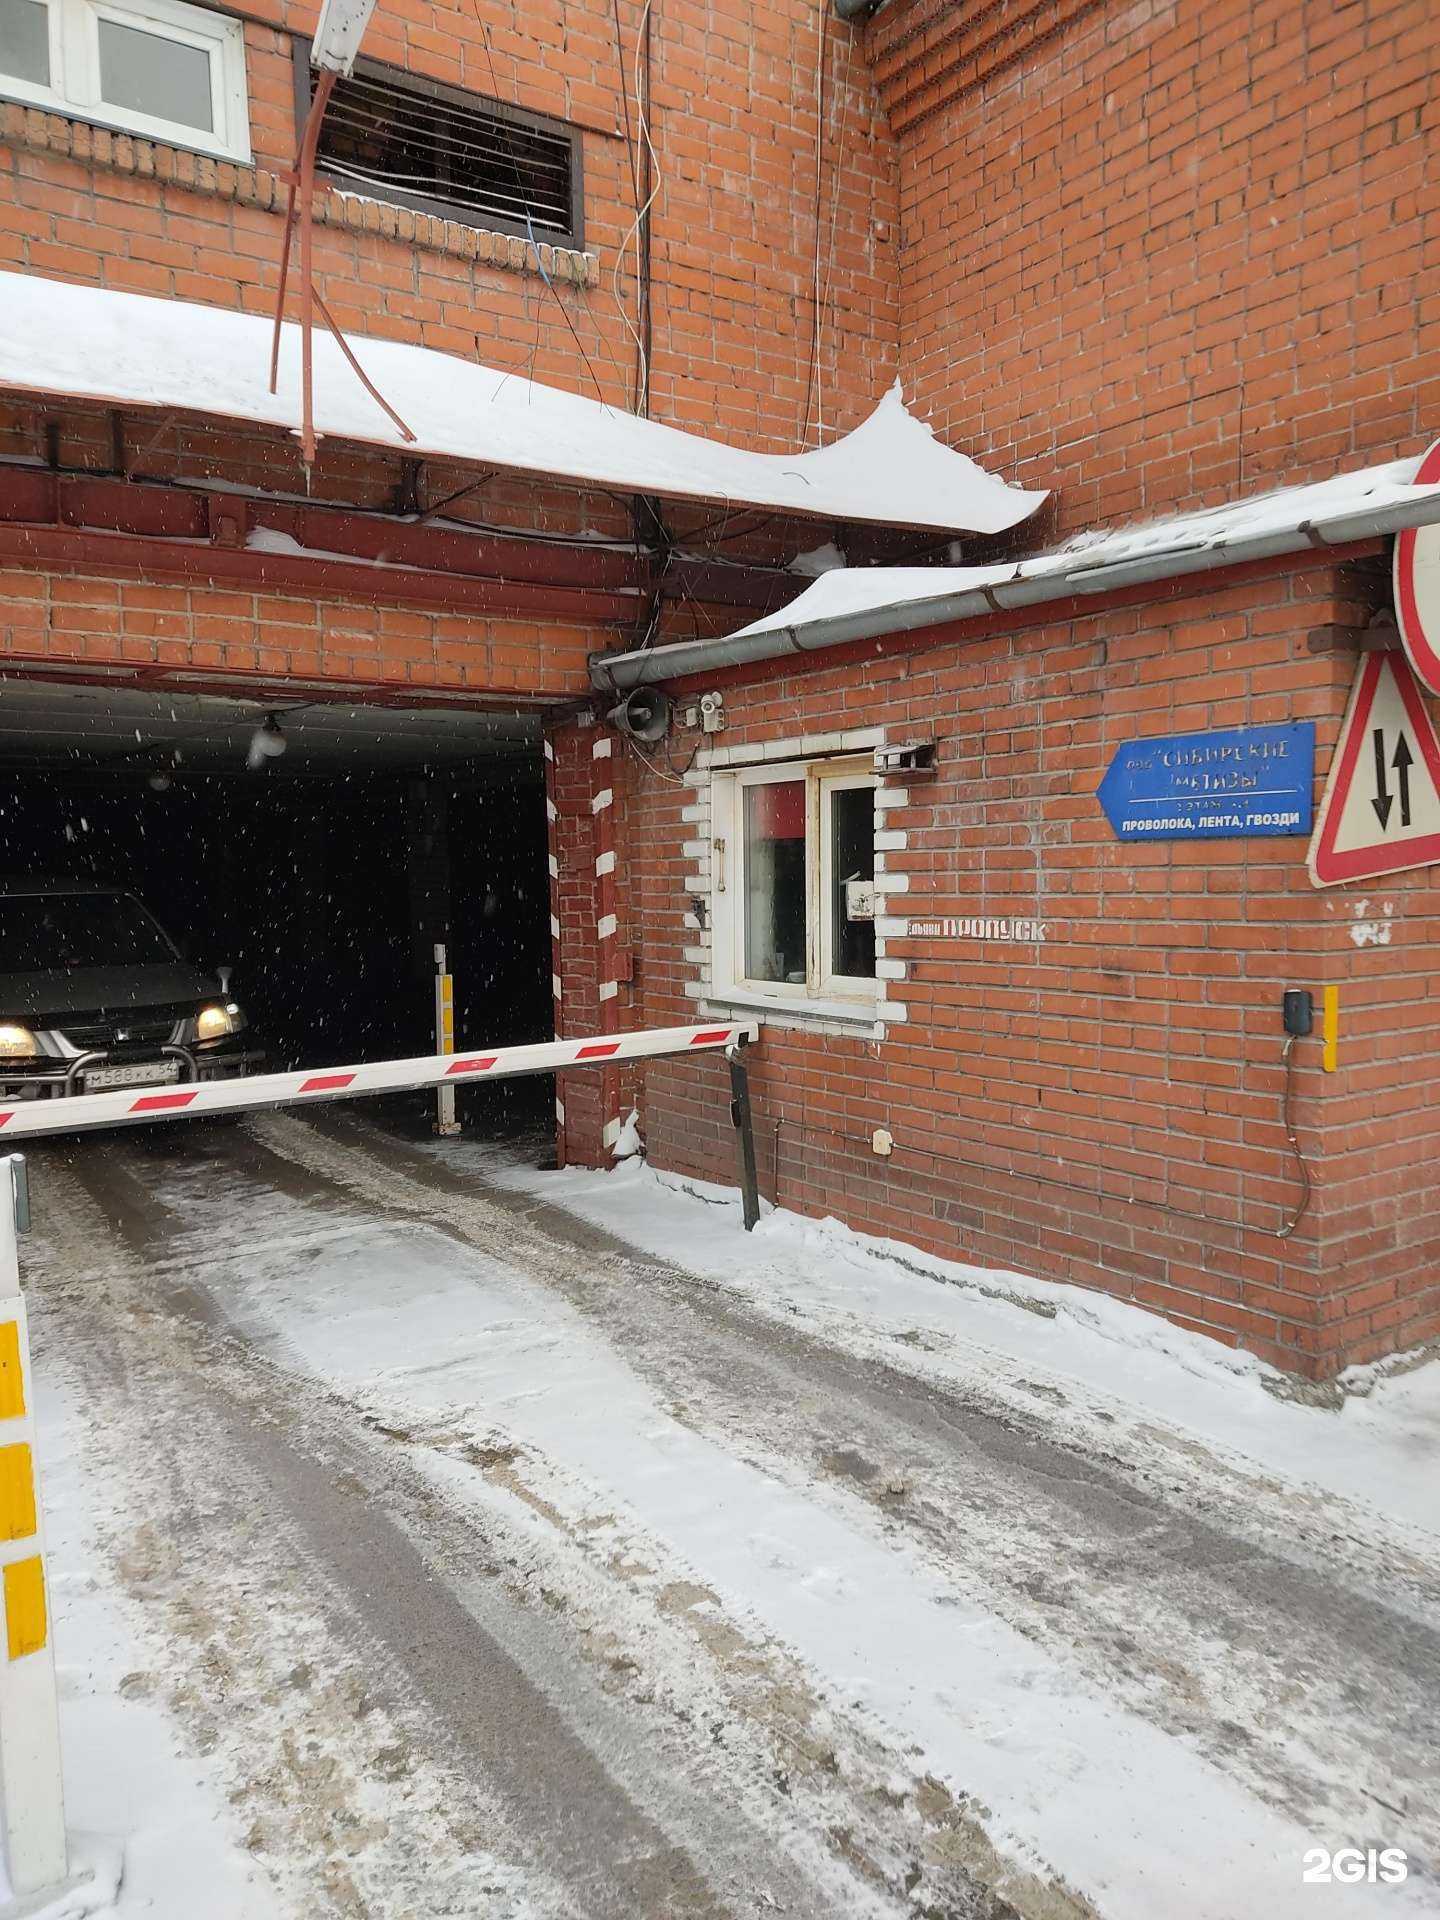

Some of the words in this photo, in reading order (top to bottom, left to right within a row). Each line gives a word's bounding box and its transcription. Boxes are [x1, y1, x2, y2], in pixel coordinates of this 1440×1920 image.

[1122, 817, 1196, 832] ПРОВОЛОКА,
[1198, 815, 1243, 829] ЛЕНТА,
[1246, 812, 1300, 826] ГВОЗДИ
